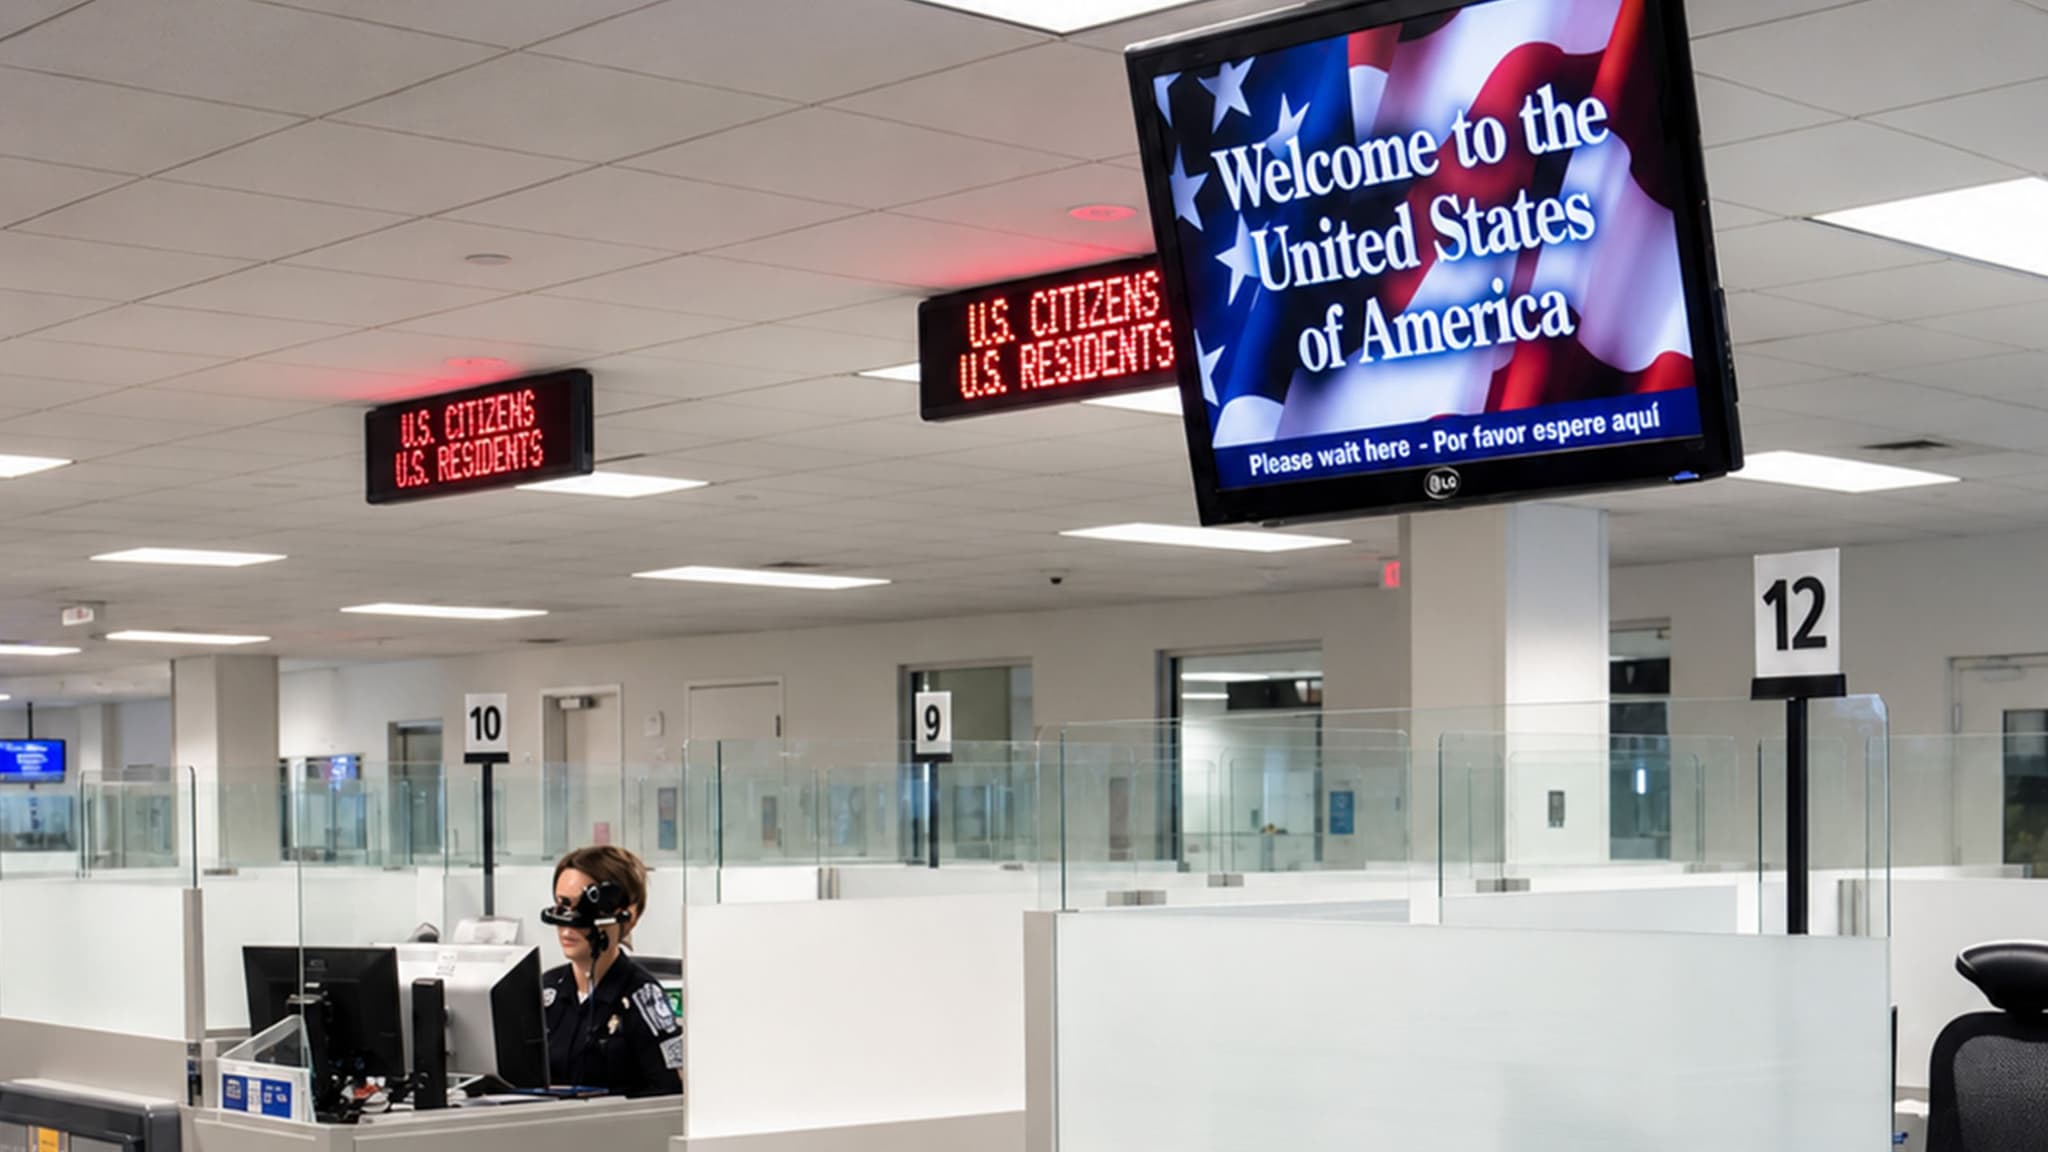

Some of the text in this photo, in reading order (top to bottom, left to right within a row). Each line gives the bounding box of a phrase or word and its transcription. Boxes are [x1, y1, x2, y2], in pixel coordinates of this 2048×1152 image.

[1210, 84, 1609, 211] Welcome to the
[1251, 190, 1596, 291] United States
[969, 270, 1160, 348] U.S. CITIZENS
[1299, 278, 1575, 373] of America
[960, 320, 1174, 398] U.S. RESIDENTS
[401, 389, 535, 448] U.S. CITIZENS
[1249, 450, 1314, 476] Please
[1318, 441, 1360, 468] wait
[1365, 437, 1410, 463] here
[1433, 429, 1468, 454] Por
[1473, 420, 1526, 449] favor
[1533, 414, 1607, 446] espere
[1612, 401, 1661, 436] aquí
[395, 429, 544, 488] U.S. RESIDENTS
[1762, 575, 1828, 651] 12
[469, 705, 502, 741] 10
[924, 704, 941, 741] 9
